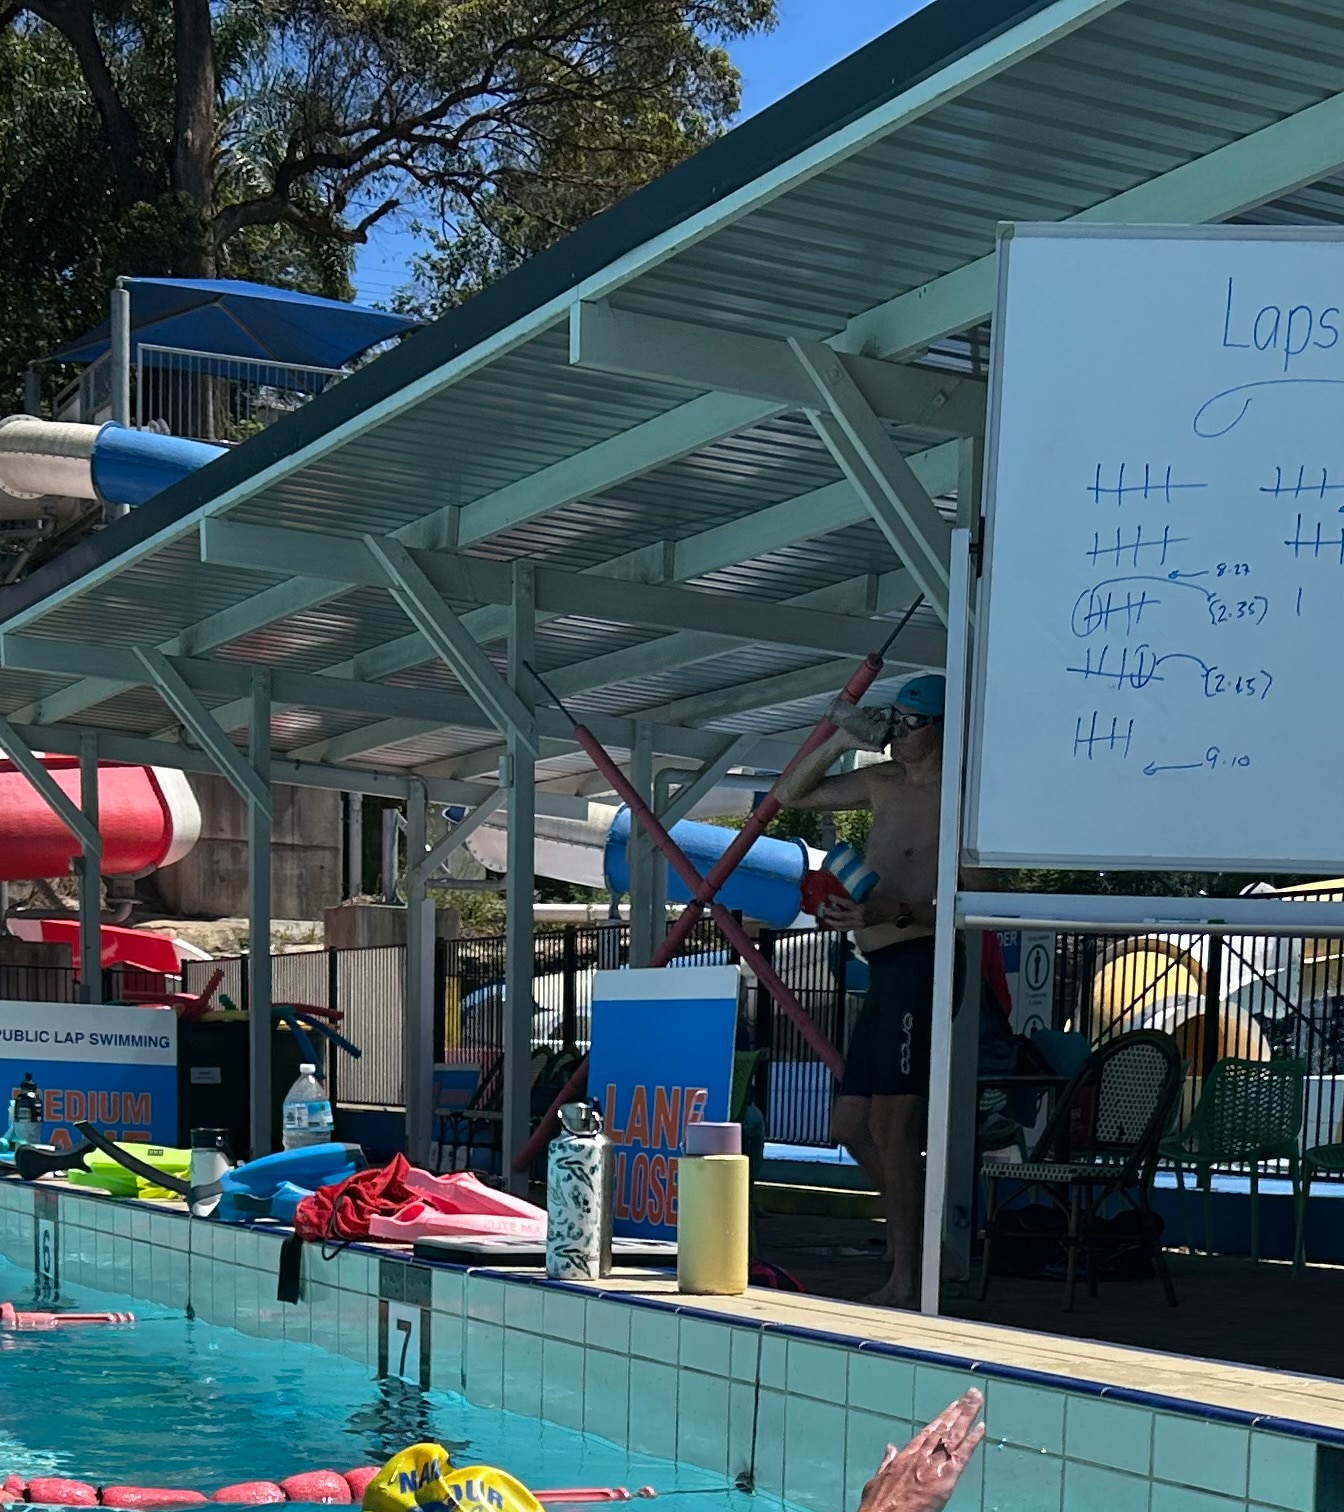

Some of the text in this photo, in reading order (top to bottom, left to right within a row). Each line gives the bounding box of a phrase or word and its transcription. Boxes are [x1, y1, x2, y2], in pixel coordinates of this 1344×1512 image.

[1222, 276, 1340, 372] Laps
[54, 1031, 86, 1045] LAP
[89, 1032, 170, 1049] SWIMMING
[11, 1087, 152, 1125] EDIUM
[612, 1151, 678, 1227] LOSE
[42, 1229, 51, 1274] 6
[396, 1318, 412, 1377] 7
